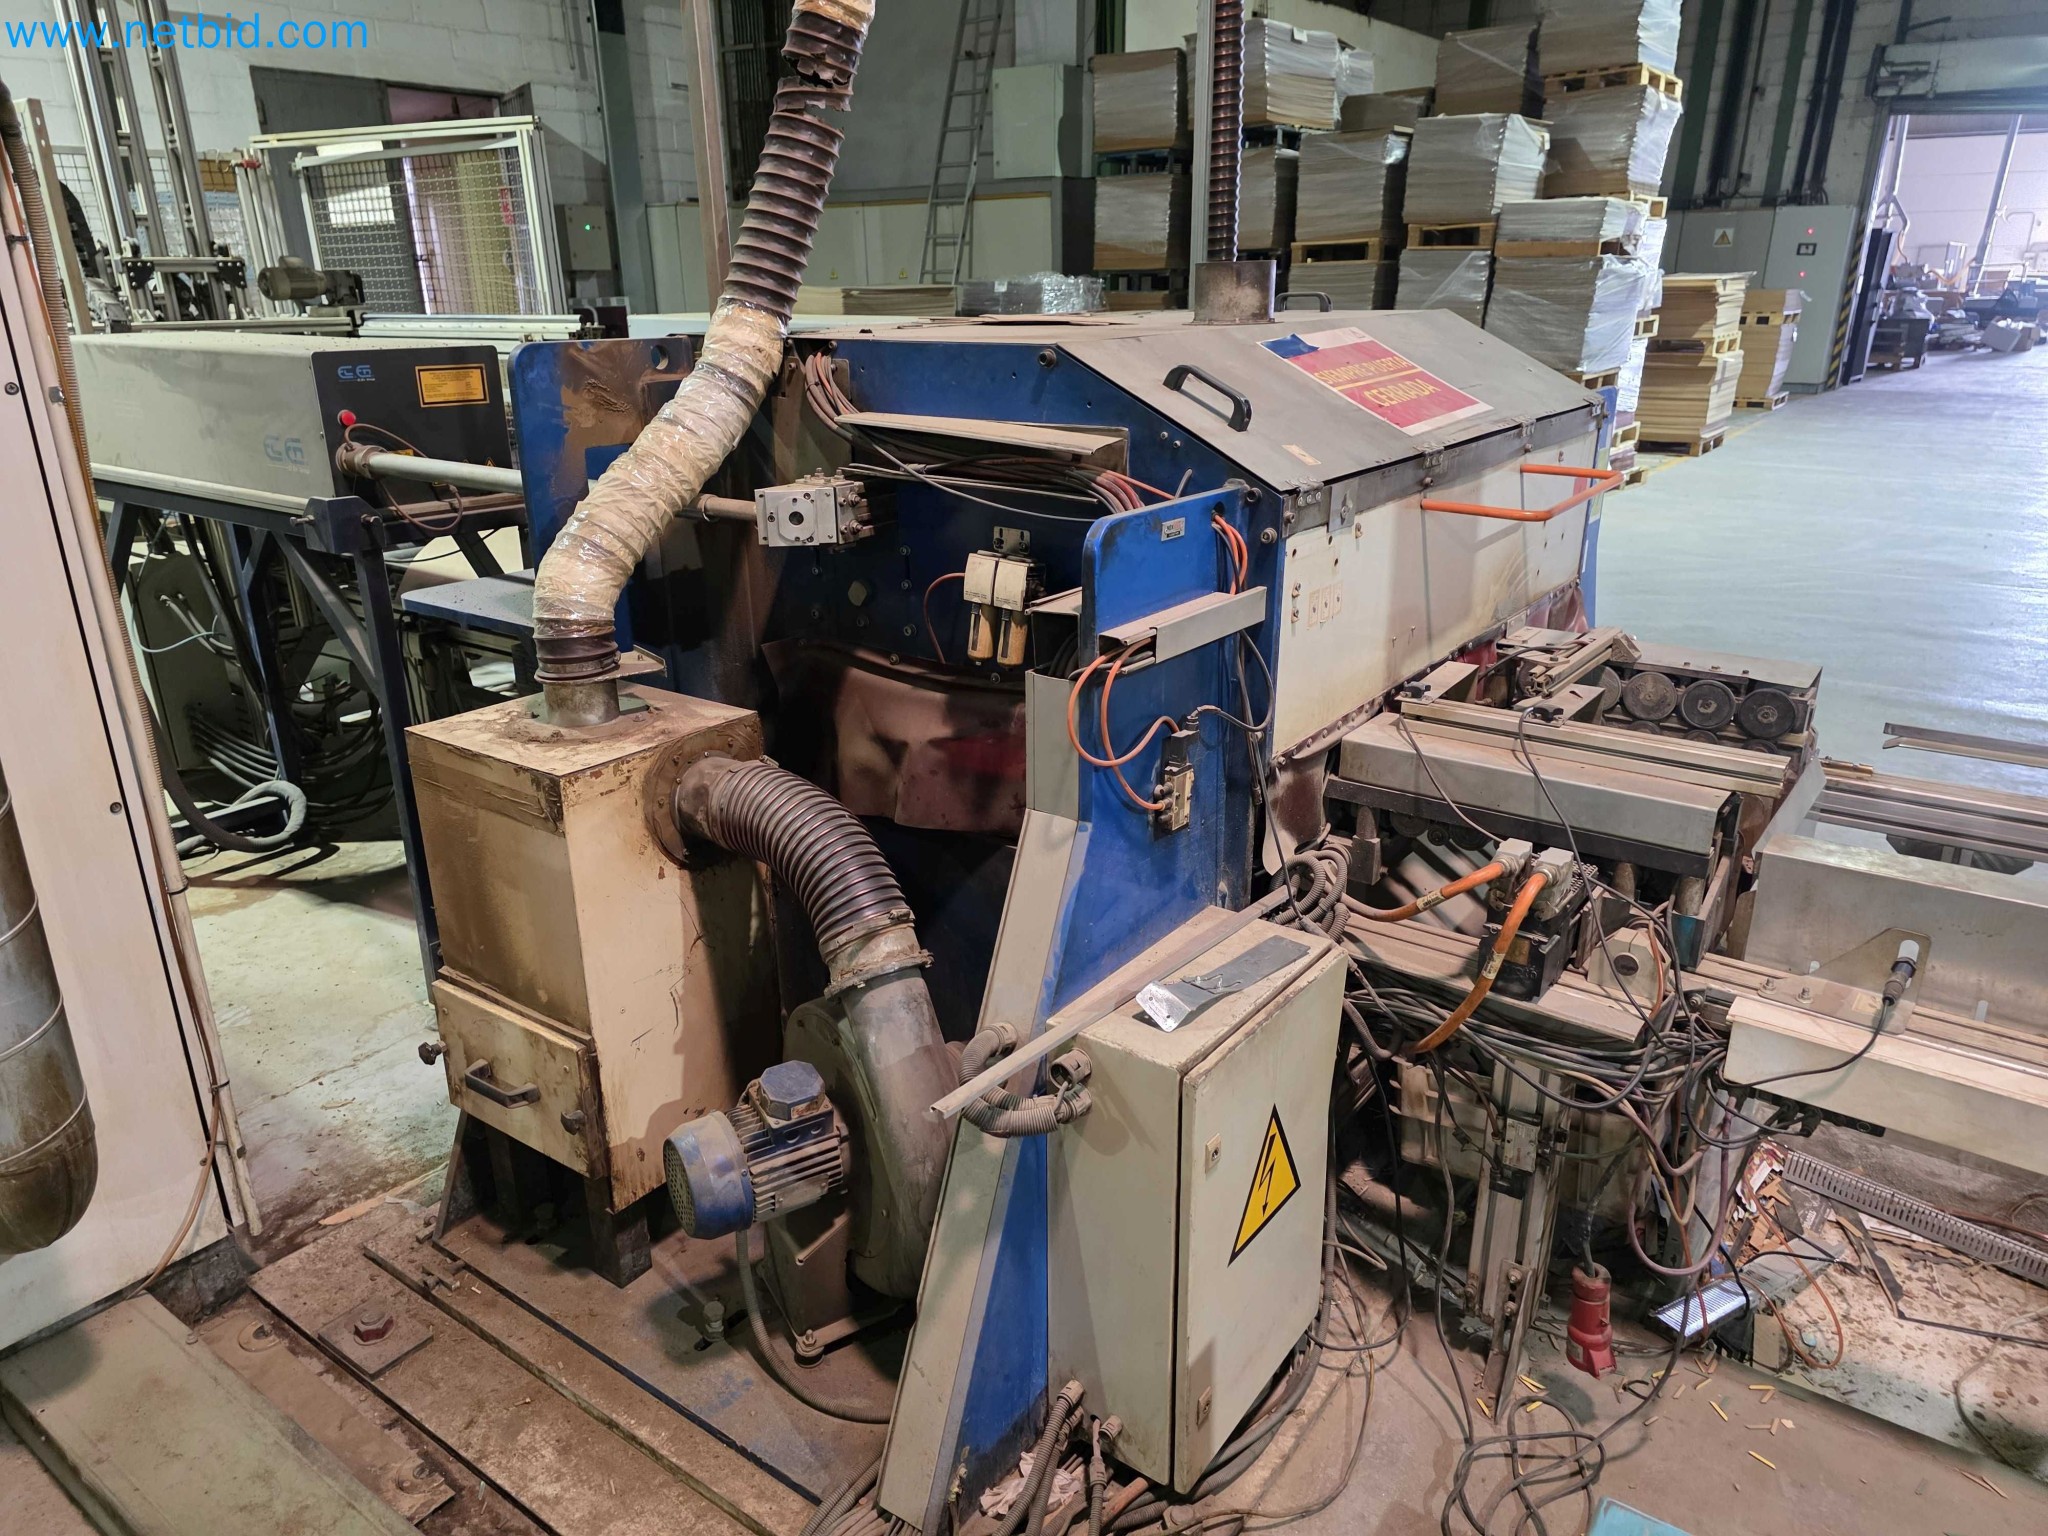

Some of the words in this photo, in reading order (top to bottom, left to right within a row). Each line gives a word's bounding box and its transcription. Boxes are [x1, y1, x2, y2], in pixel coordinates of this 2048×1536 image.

[1313, 363, 1370, 385] SIEMPRE
[1366, 356, 1413, 377] PUERTA
[1363, 378, 1441, 407] CERRADA
